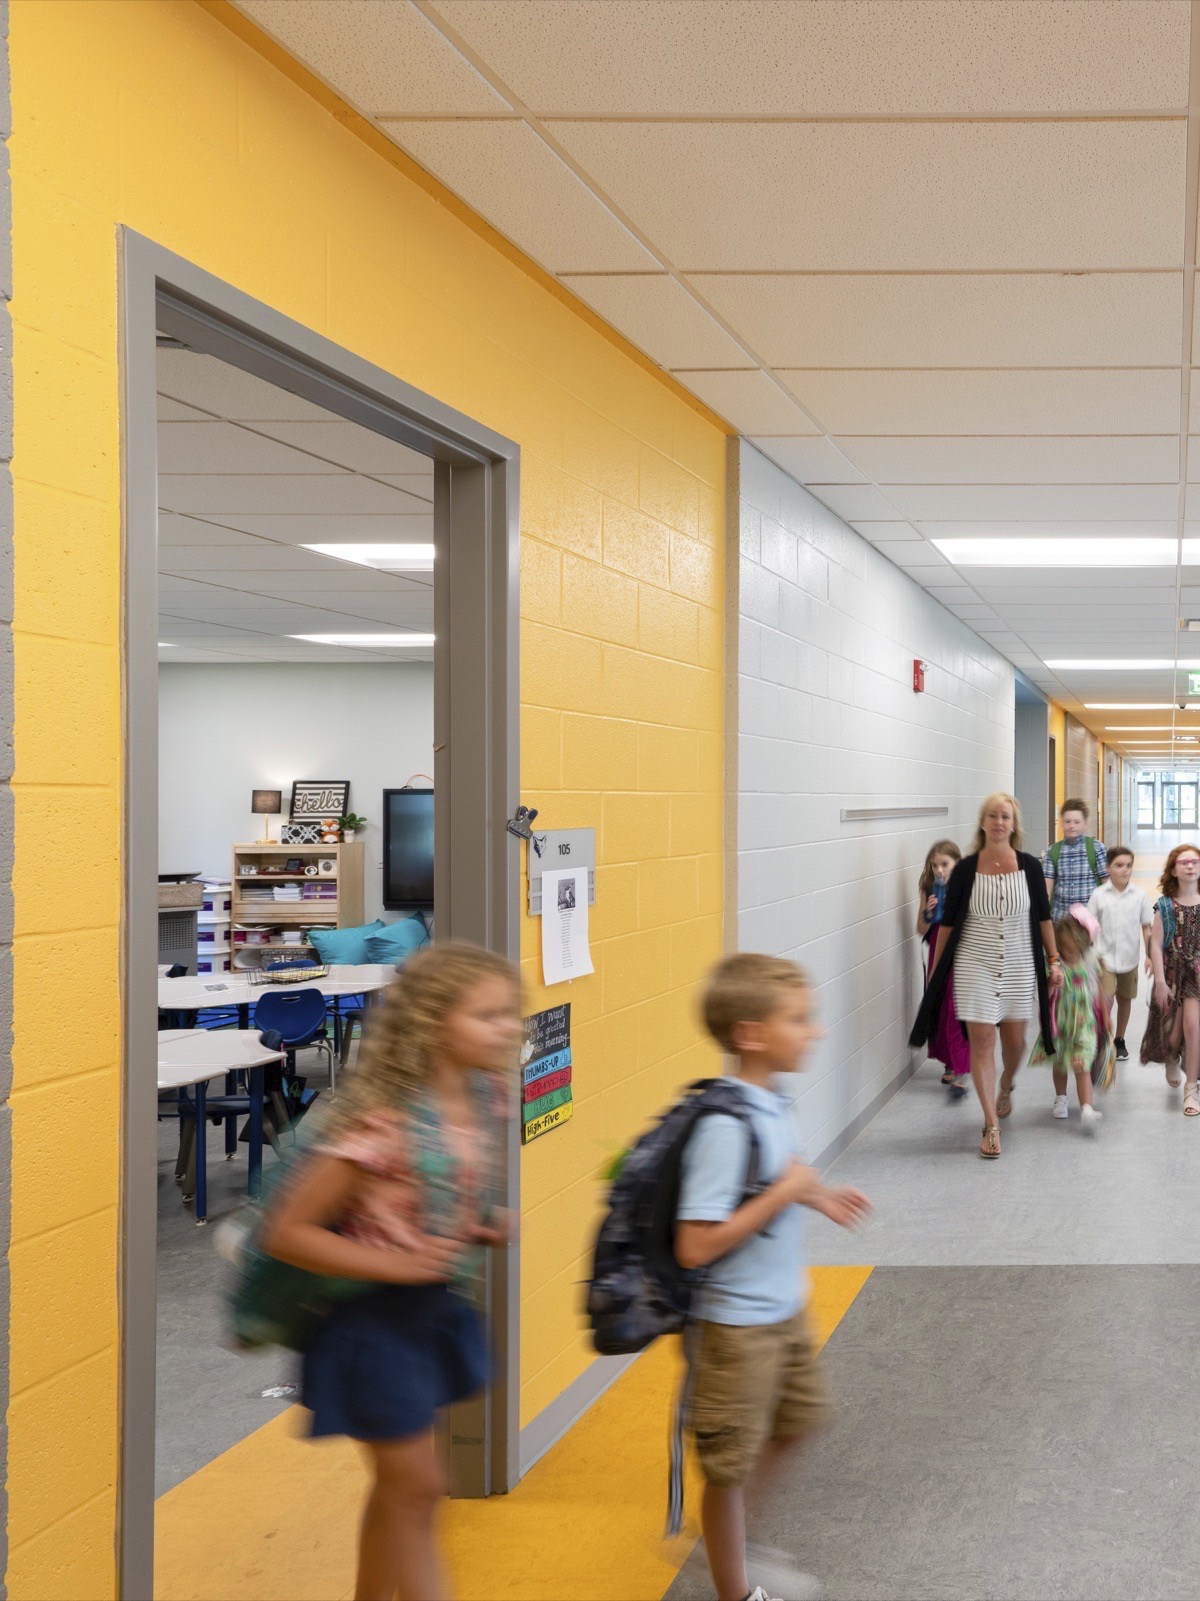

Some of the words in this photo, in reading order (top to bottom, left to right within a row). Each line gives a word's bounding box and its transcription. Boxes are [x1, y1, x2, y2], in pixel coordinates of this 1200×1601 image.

[295, 788, 342, 813] hello
[558, 843, 571, 855] 105
[537, 1028, 544, 1040] be
[527, 1111, 560, 1137] High-Five
